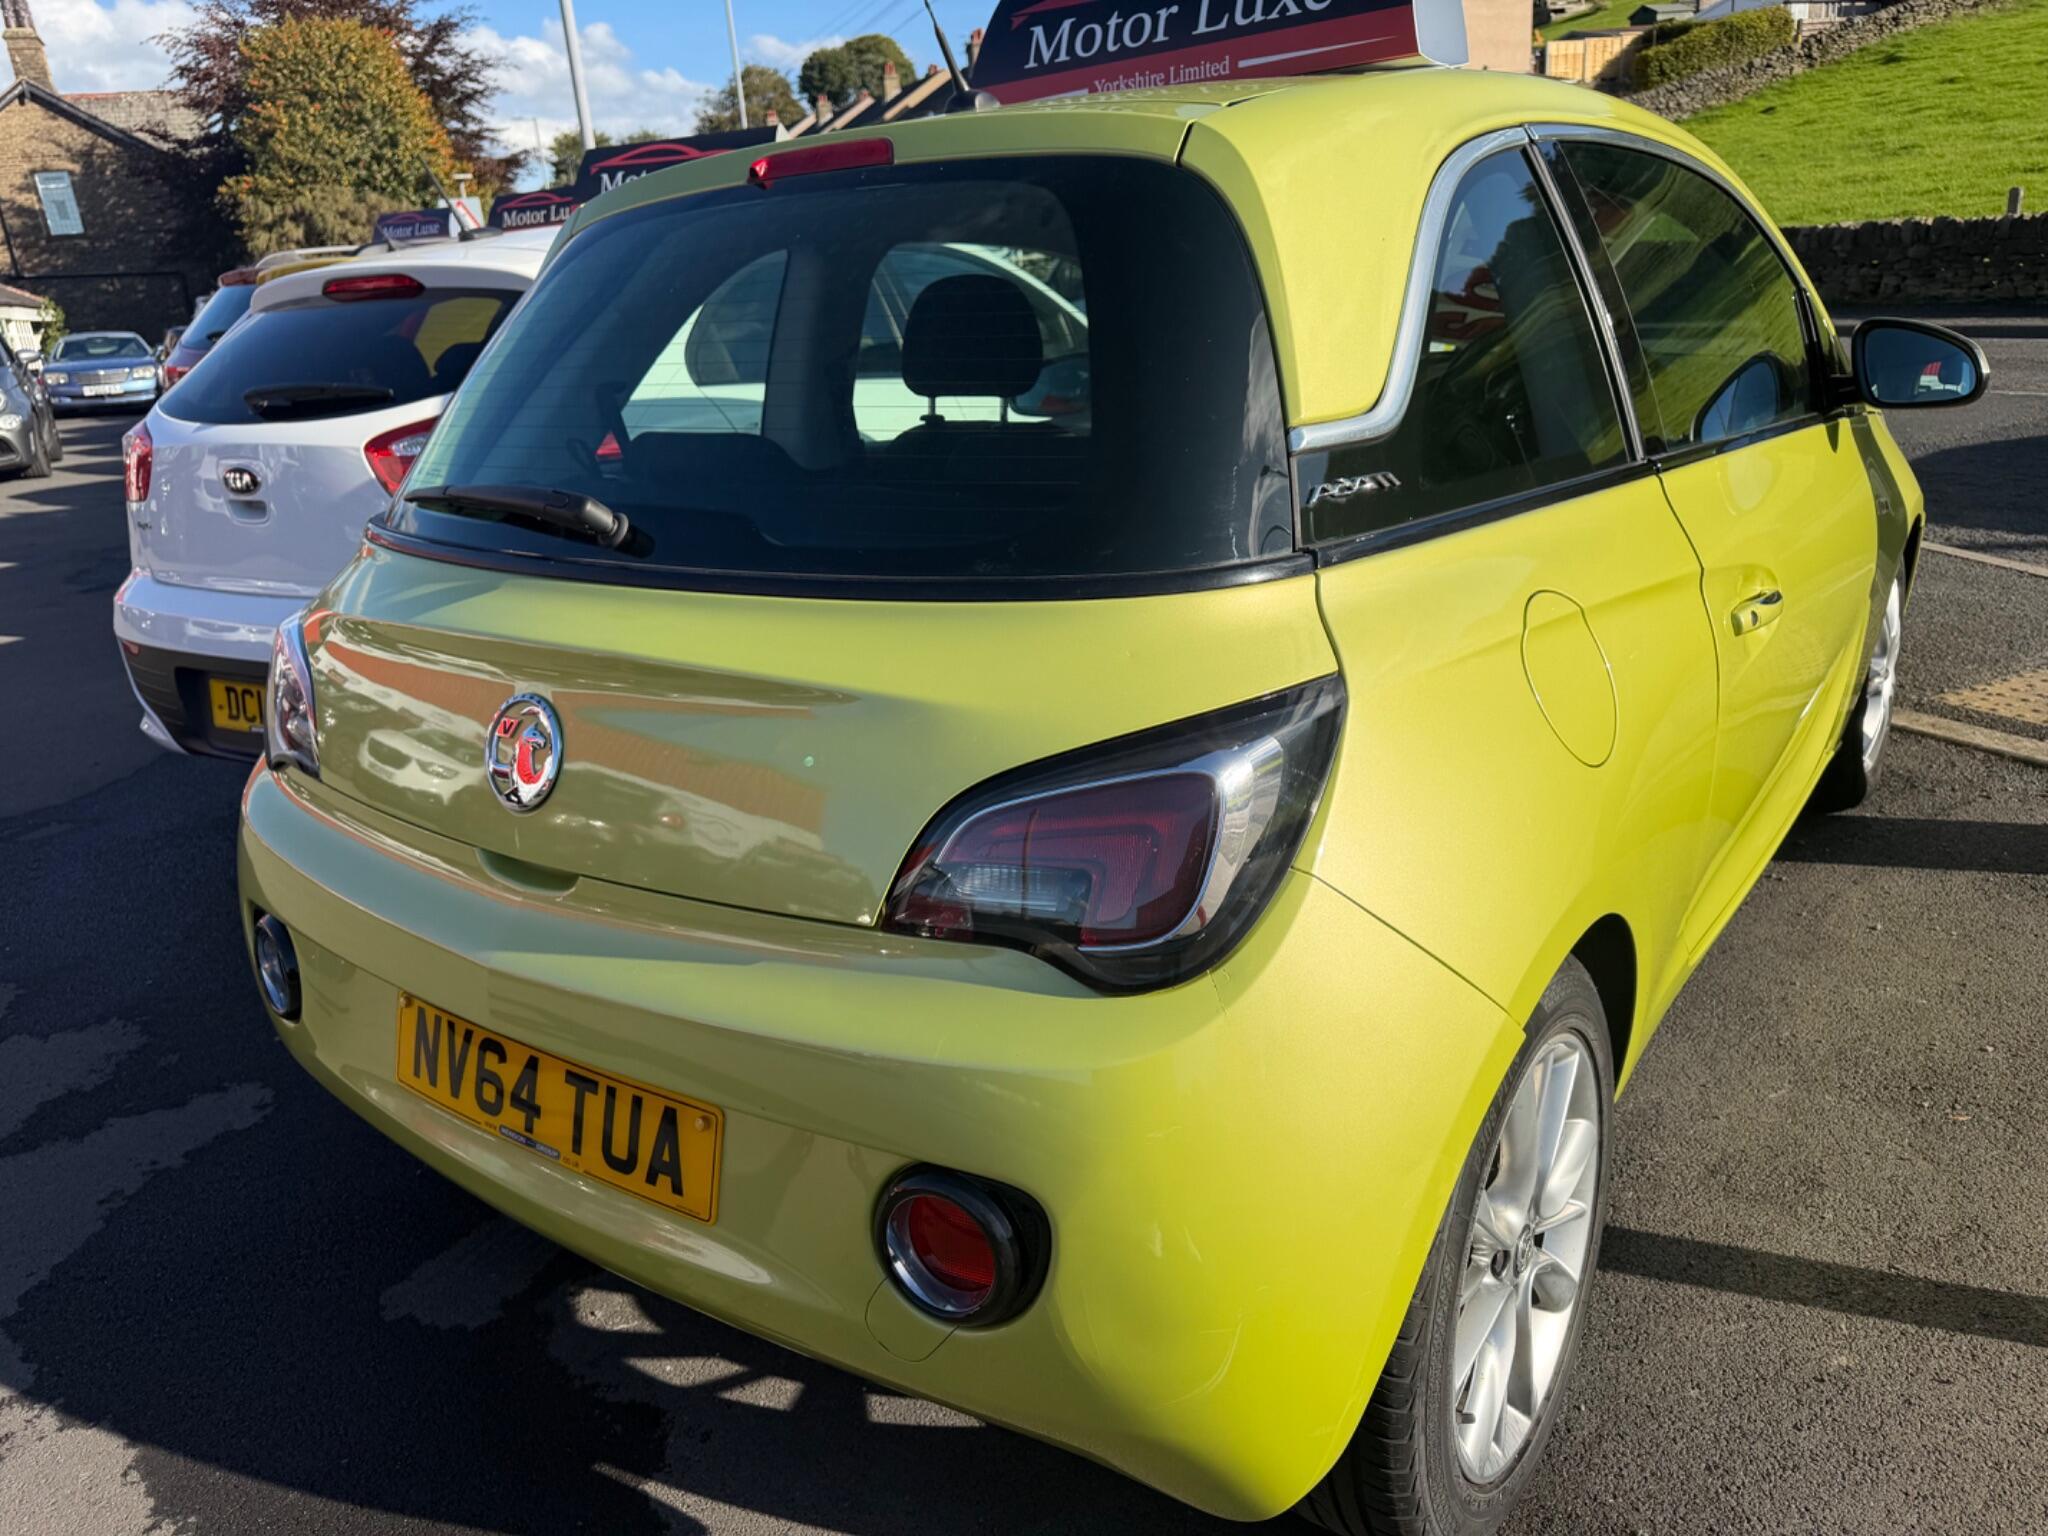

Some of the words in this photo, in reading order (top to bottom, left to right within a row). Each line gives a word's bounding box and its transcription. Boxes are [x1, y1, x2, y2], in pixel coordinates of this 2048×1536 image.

[1024, 3, 1179, 69] Motor
[1093, 70, 1165, 93] Yorkshire
[1169, 55, 1230, 84] Limited
[502, 209, 547, 228] Motor
[413, 1006, 541, 1135] NV64
[565, 1069, 684, 1197] TUA
